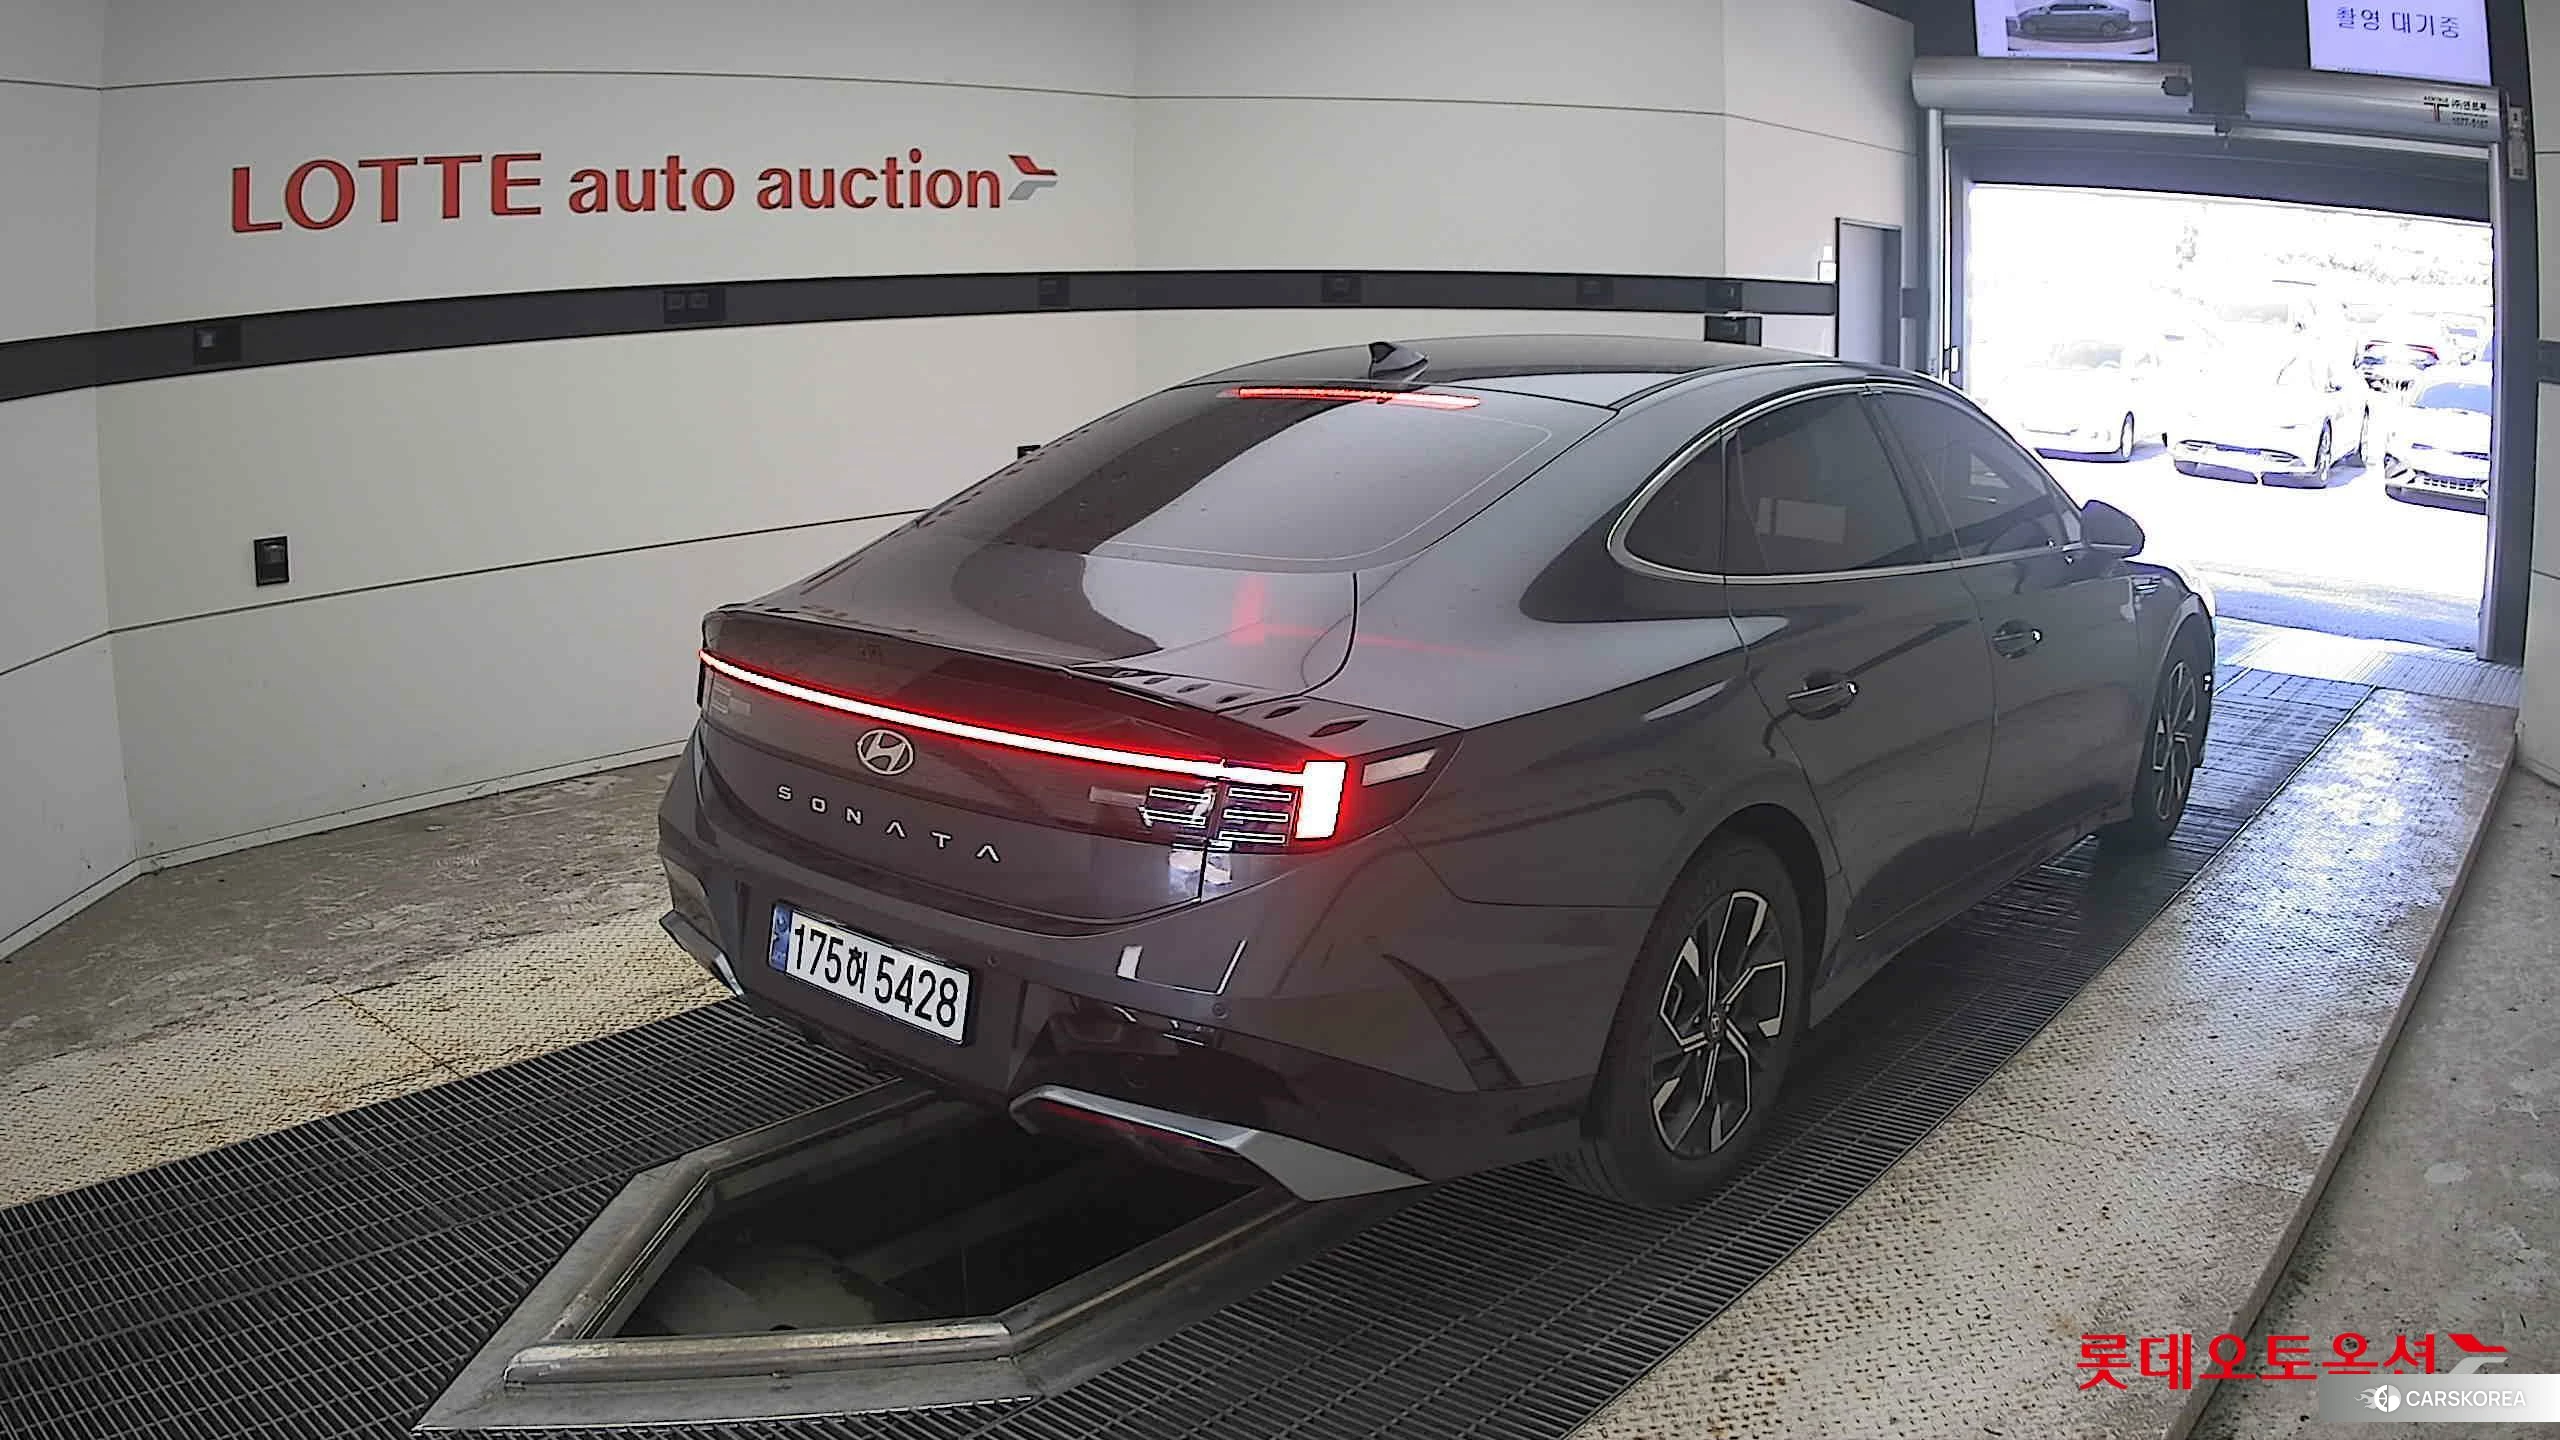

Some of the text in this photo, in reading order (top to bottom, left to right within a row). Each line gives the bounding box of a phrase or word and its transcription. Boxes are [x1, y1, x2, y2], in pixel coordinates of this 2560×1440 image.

[2337, 6, 2459, 39] 촬영 대기중
[231, 148, 1001, 233] LOTTE auto auction
[777, 785, 1000, 863] SONATA
[794, 924, 959, 1028] 175허 5428
